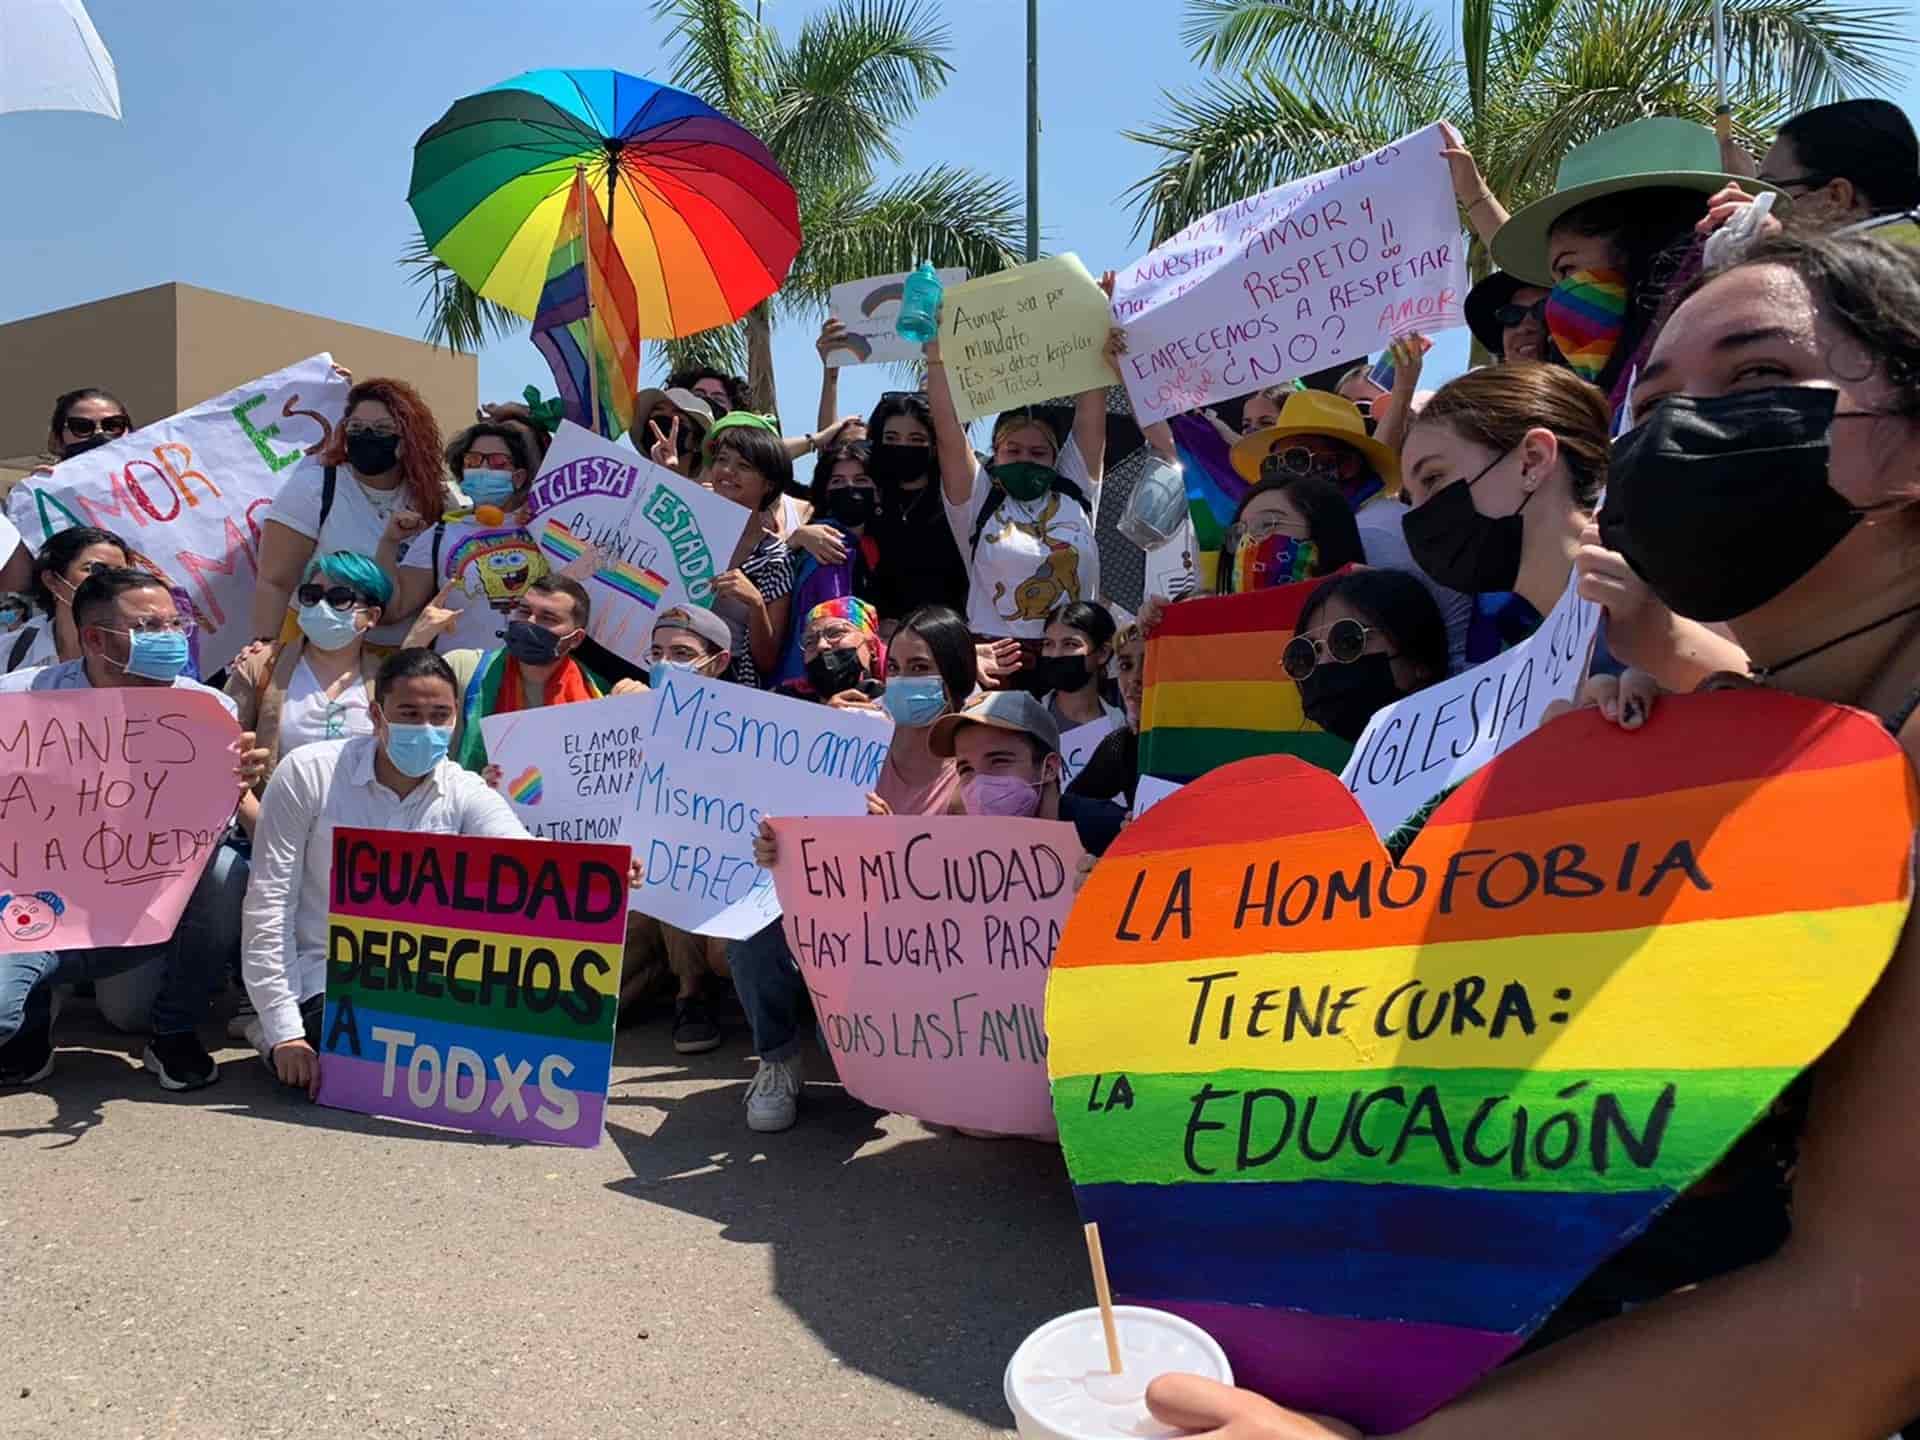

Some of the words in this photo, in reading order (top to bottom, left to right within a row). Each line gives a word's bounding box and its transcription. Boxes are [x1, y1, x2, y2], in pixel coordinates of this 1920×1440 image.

[1244, 199, 1346, 260] AMOR
[1130, 313, 1280, 381] EMPECEMOS
[1296, 297, 1313, 321] A
[1329, 244, 1454, 313] RESPETAR
[1376, 287, 1457, 331] AMOR
[33, 442, 223, 539] AMOR
[230, 392, 333, 473] ES
[532, 457, 631, 513] IGLESIA
[568, 510, 659, 570] ASUNTO
[646, 491, 713, 600] ESTADO
[563, 734, 584, 755] EL
[588, 725, 644, 751] AMOR
[1349, 656, 1535, 794] IGLESIA
[76, 769, 169, 820] HOY
[567, 747, 644, 777] SIEMPR
[44, 837, 68, 872] A
[82, 820, 215, 875] QUEDA
[525, 815, 623, 842] ATRIMON
[335, 835, 624, 925] IGUALDAD
[1115, 867, 1194, 943] LA
[1233, 837, 1715, 930] HOMOFOBIA
[328, 924, 612, 1026] DERECHOS
[983, 914, 1061, 971] PARA
[953, 992, 1049, 1065] FAMIL
[1186, 970, 1368, 1046] TIENE
[1373, 974, 1574, 1041] CURA:
[325, 993, 361, 1057] A
[371, 1025, 581, 1131] TODXS
[1085, 1072, 1136, 1114] LA
[1182, 1078, 1678, 1180] EDUCACIÓN
